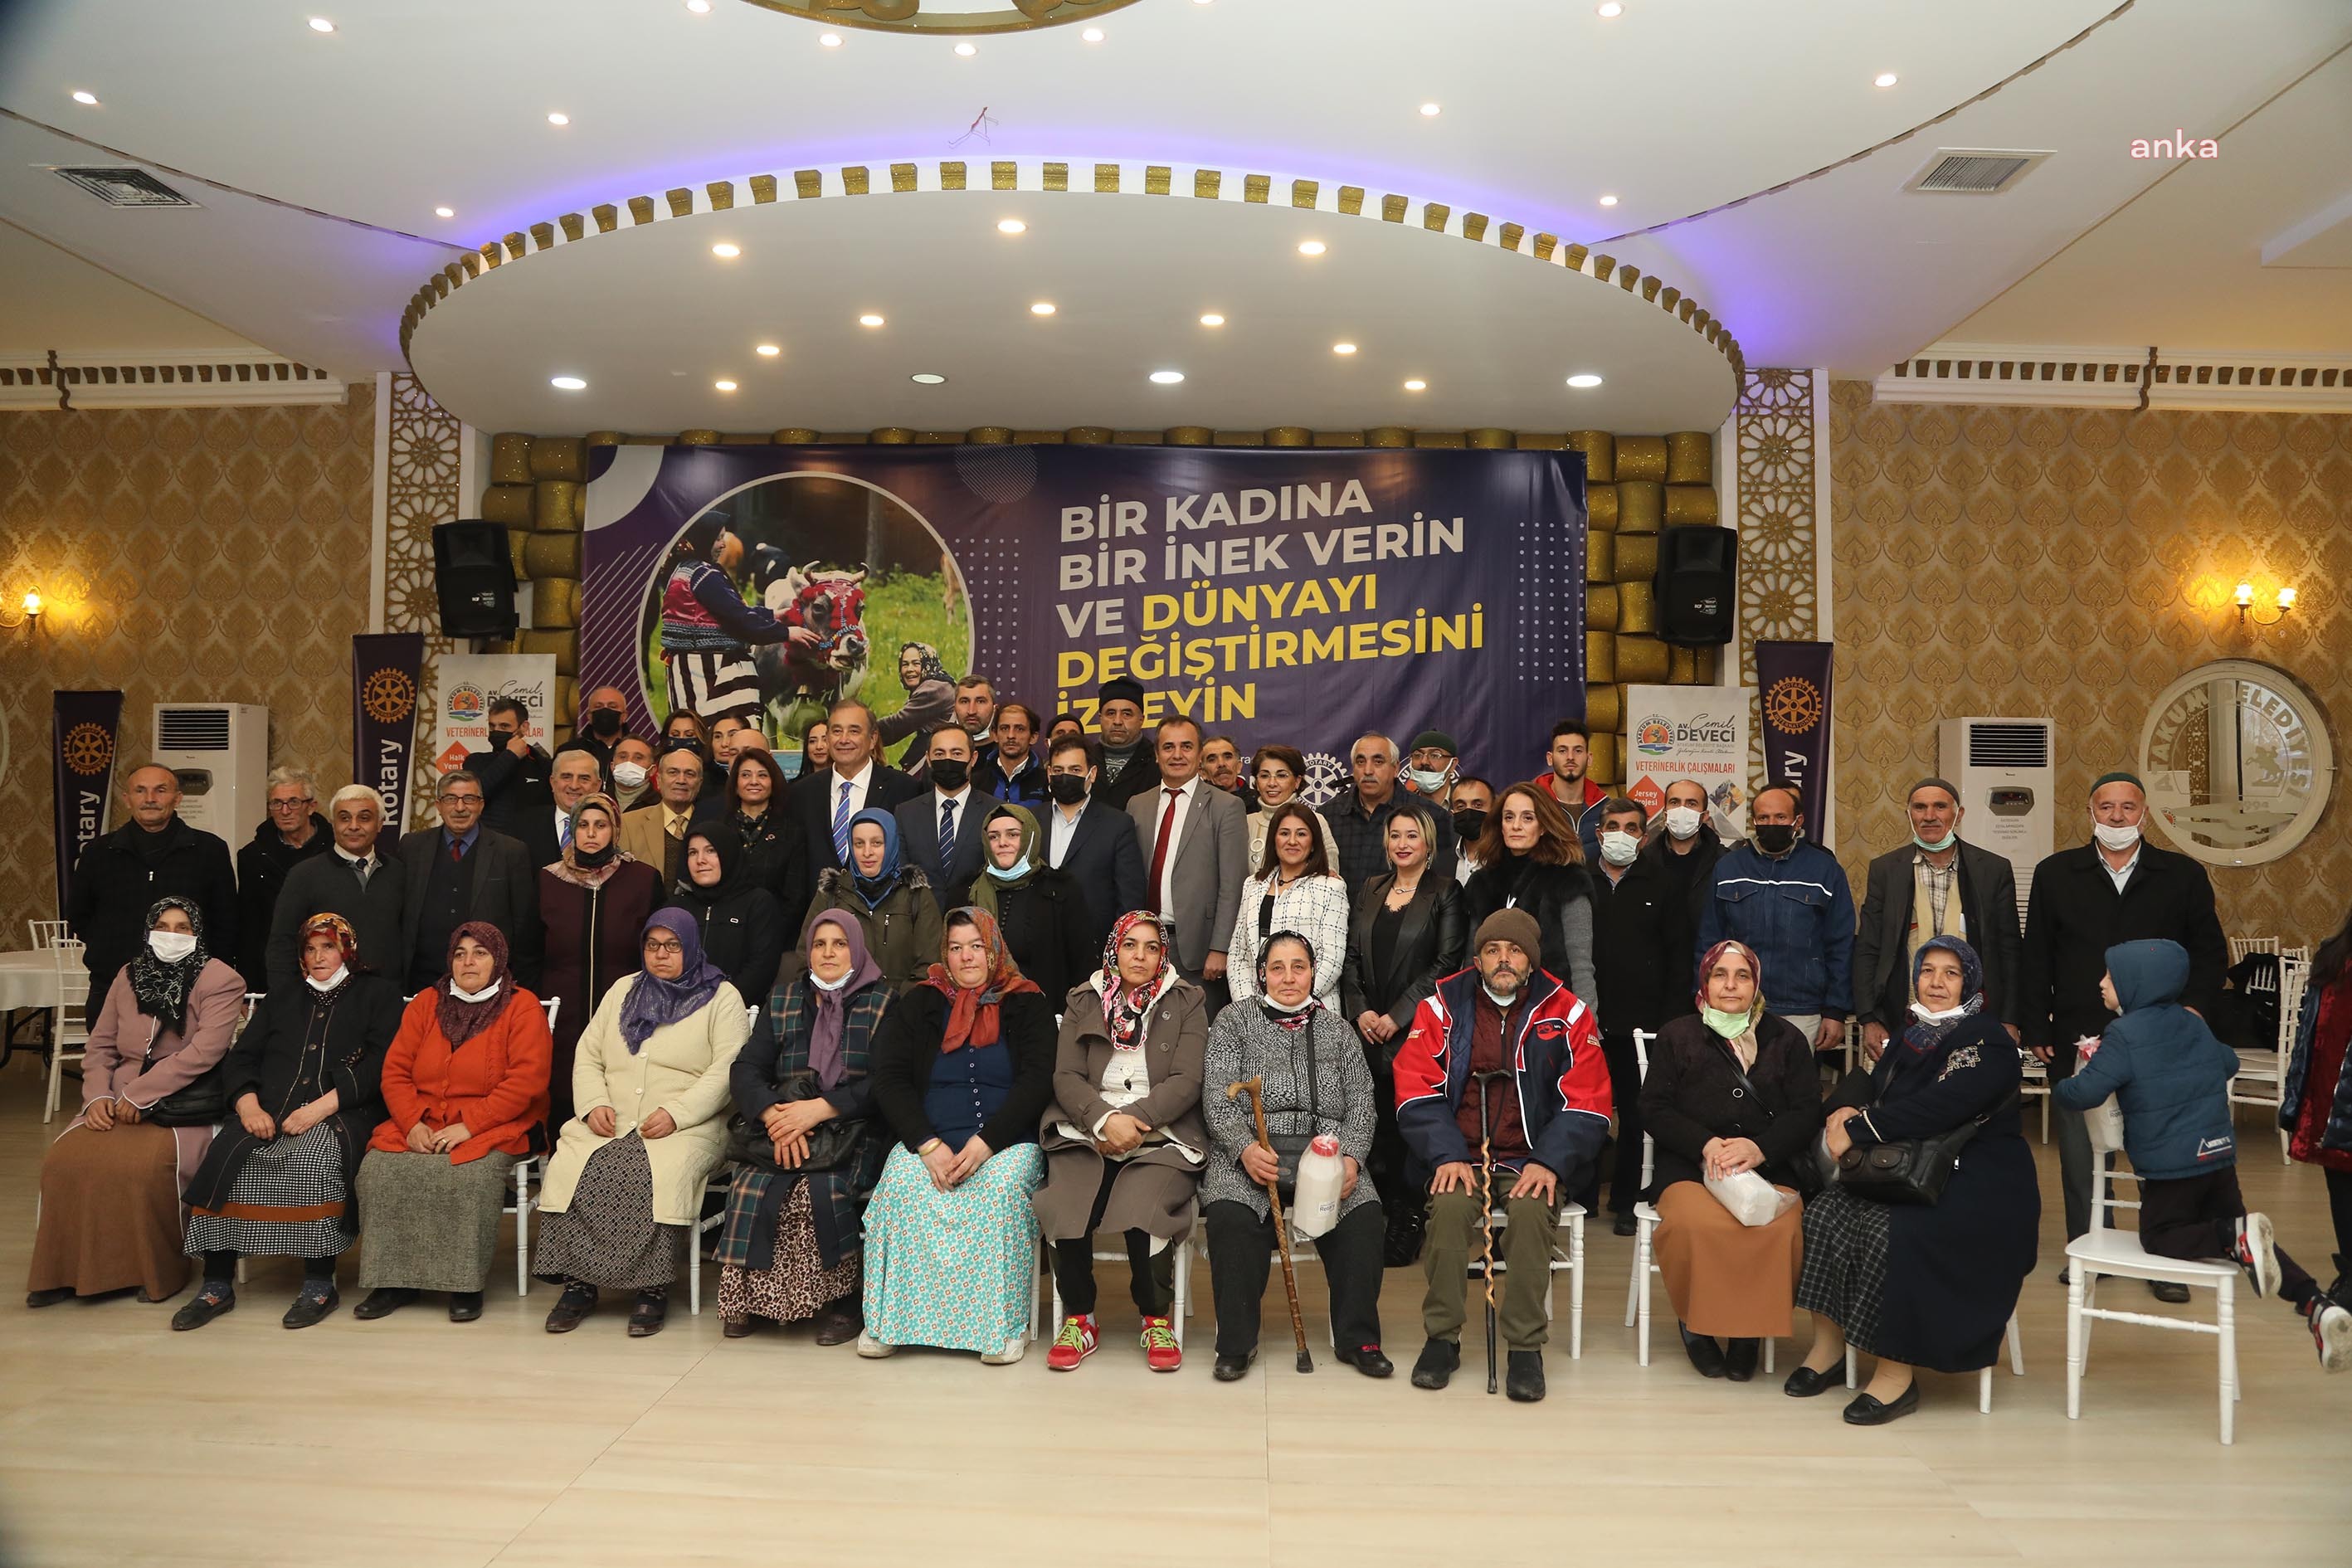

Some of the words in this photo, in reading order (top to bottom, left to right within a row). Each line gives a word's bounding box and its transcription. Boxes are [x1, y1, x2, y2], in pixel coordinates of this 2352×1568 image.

[1061, 494, 1147, 543] BİR
[1166, 480, 1372, 532] KADINA
[1060, 543, 1146, 590] BİR
[1166, 533, 1288, 580] İNEK
[1303, 512, 1463, 565] VERİN
[1056, 598, 1123, 638] VE
[1143, 574, 1376, 631] DÜNYAYI
[1058, 603, 1482, 688] DEĞİŞTİRMESİNİ
[499, 679, 543, 698] Cemil
[1781, 682, 1806, 690] ROTARY
[487, 693, 543, 707] DECİ
[1056, 677, 1255, 734] İZEYİN
[446, 724, 489, 737] VETERİNERL
[1689, 713, 1736, 731] Cemil
[1677, 727, 1735, 742] DEVECİ
[2150, 687, 2209, 791] ATAKUM
[1305, 759, 1332, 768] ROTARY
[1635, 759, 1686, 772] VETERİNERLİK
[1687, 762, 1735, 774] ÇALIŞMALARI
[1634, 790, 1658, 798] Jersey
